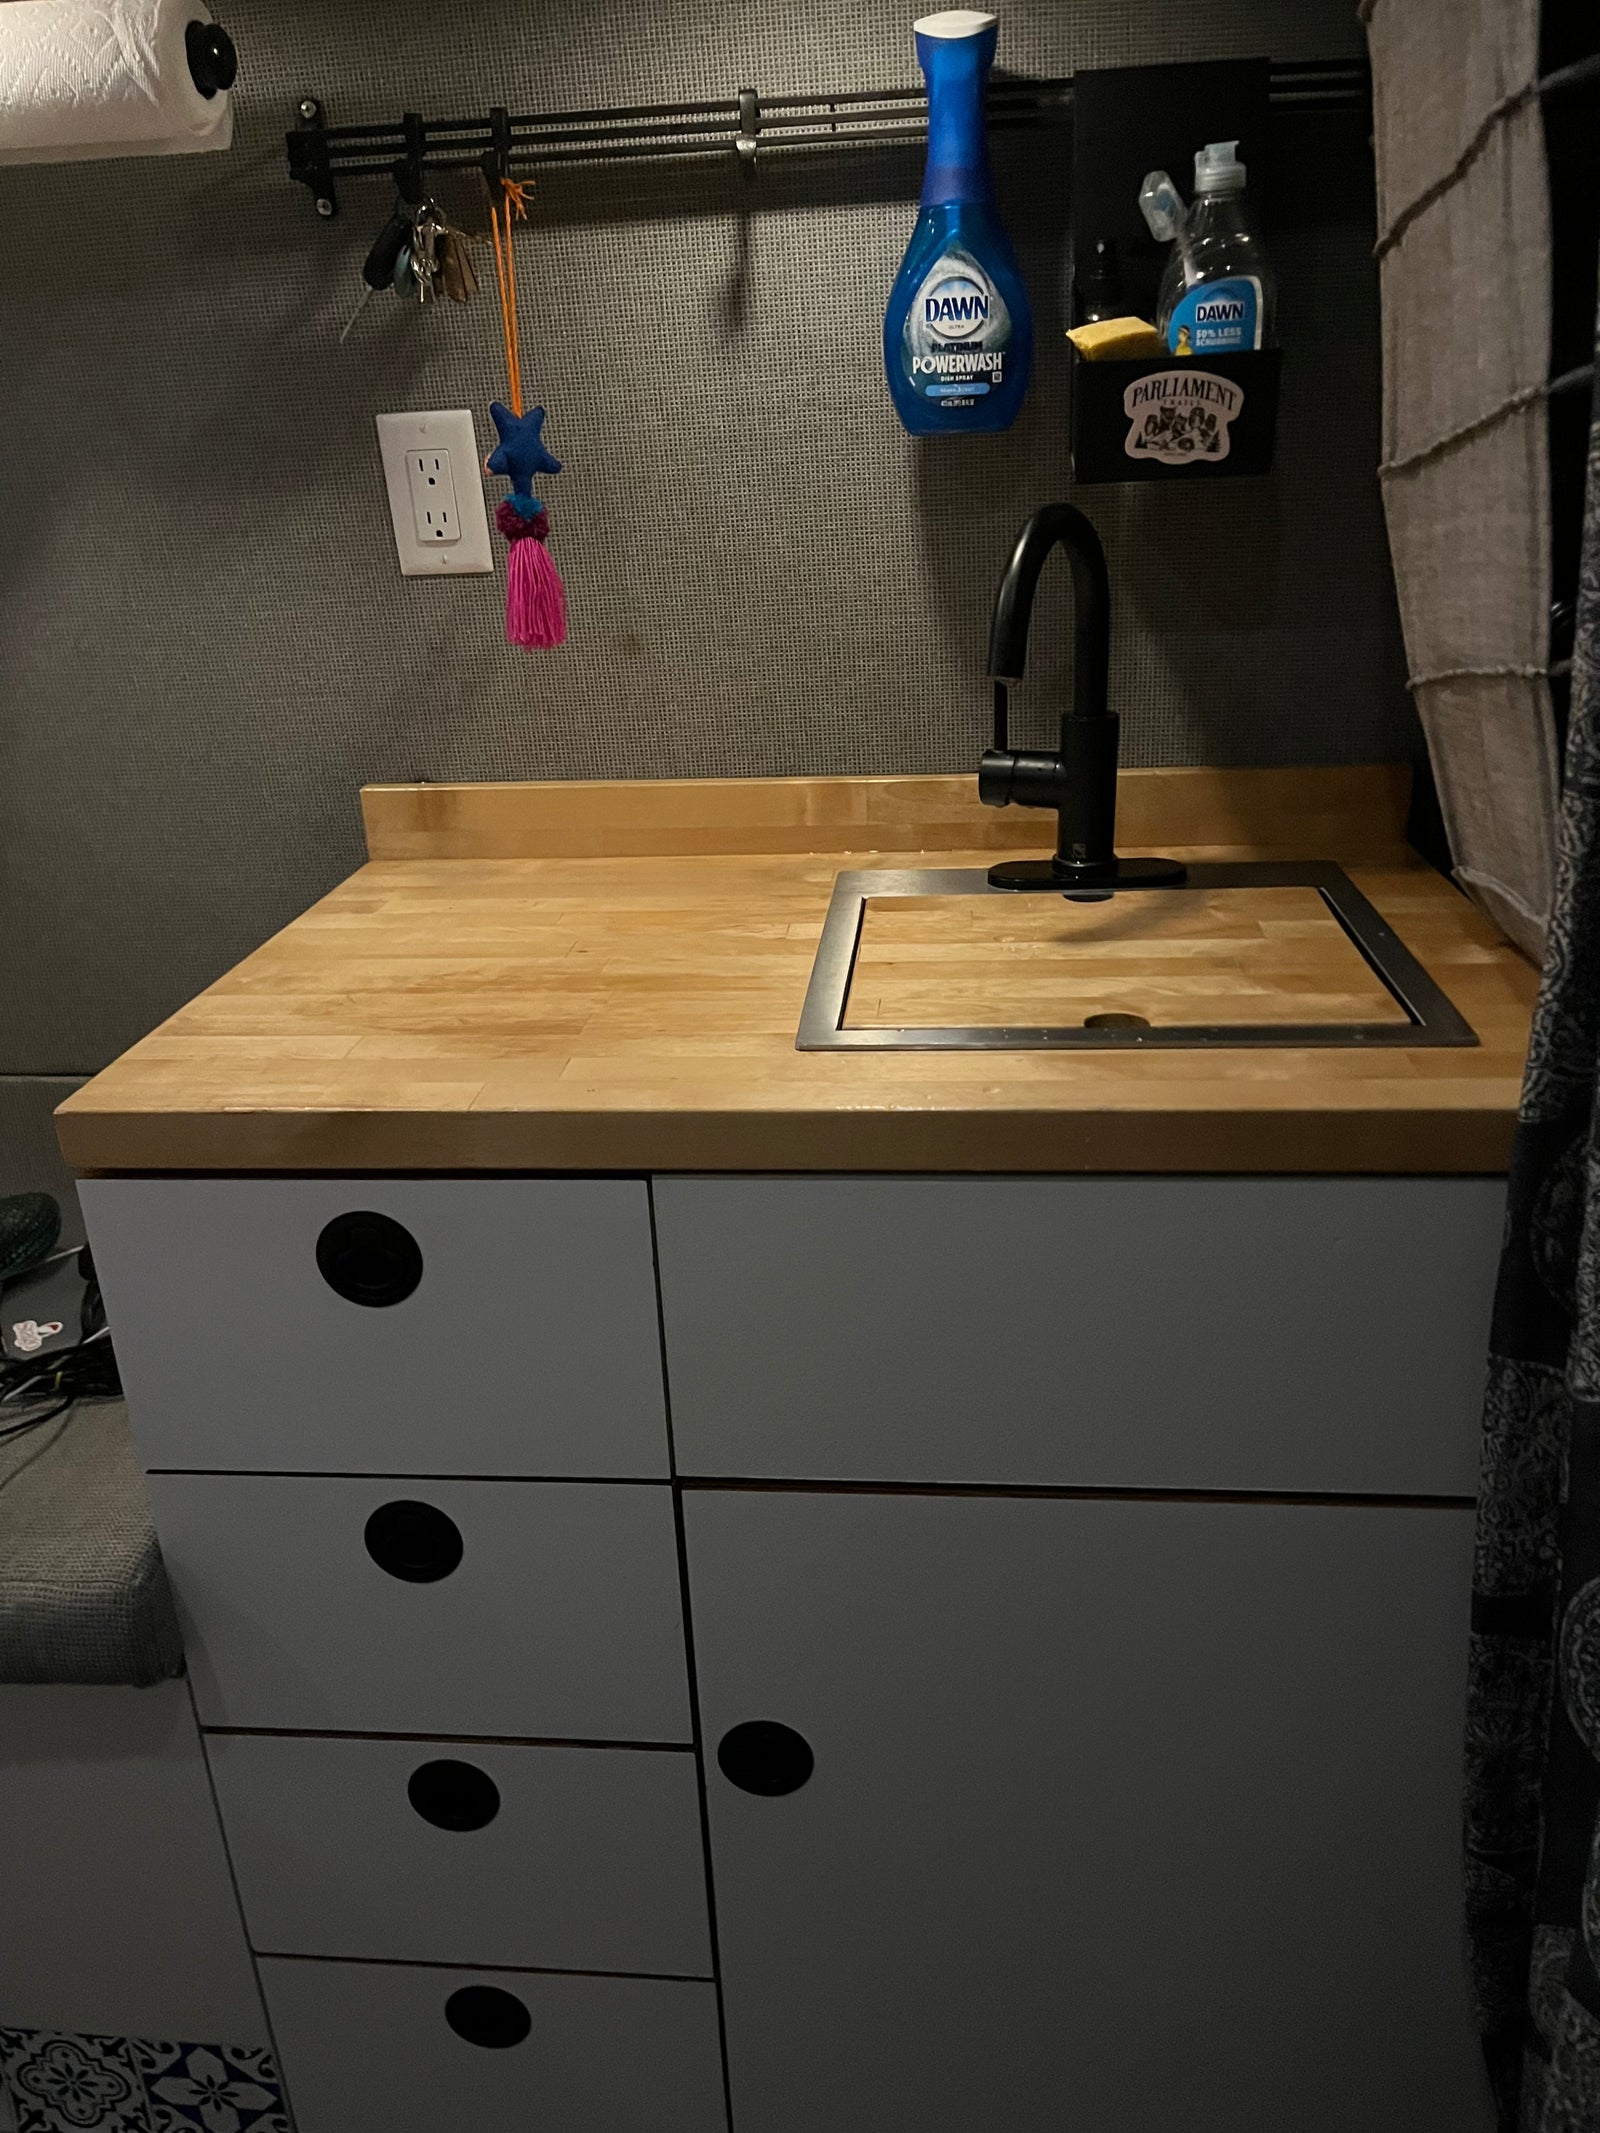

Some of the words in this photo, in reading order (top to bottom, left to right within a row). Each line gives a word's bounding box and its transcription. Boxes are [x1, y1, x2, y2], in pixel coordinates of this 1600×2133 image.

[925, 295, 989, 323] DAWN
[1196, 303, 1244, 322] DAWN
[1196, 329, 1217, 339] 50%
[1218, 327, 1242, 337] LESS
[912, 352, 1002, 375] POWERWASH
[1132, 377, 1238, 411] PARLIAMENT
